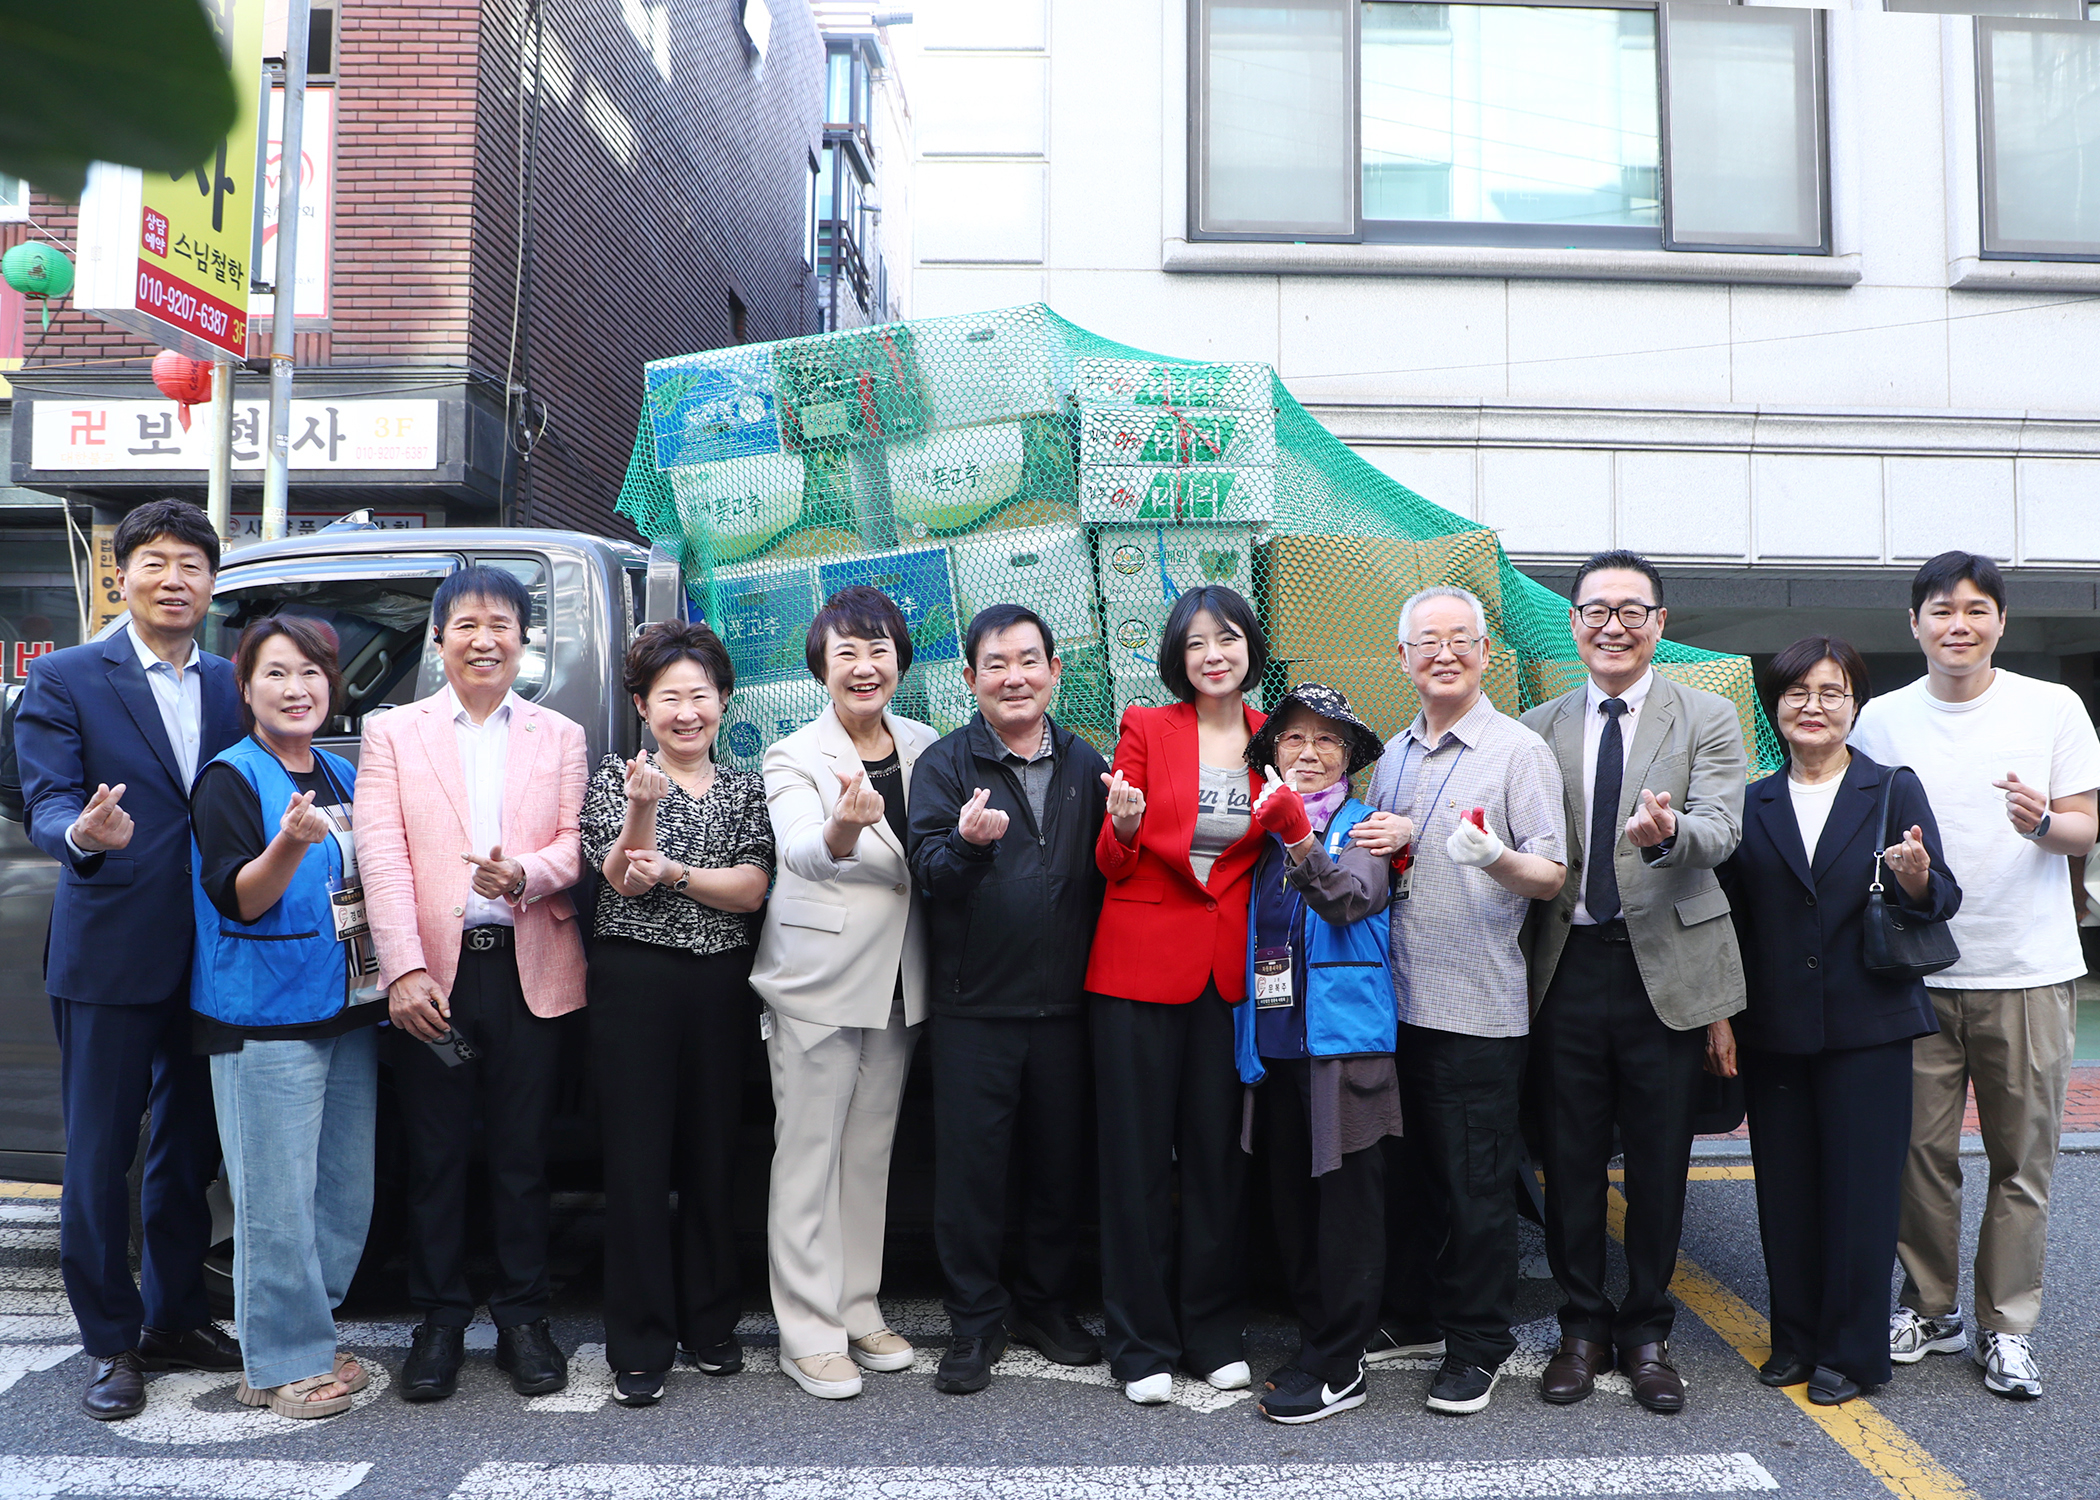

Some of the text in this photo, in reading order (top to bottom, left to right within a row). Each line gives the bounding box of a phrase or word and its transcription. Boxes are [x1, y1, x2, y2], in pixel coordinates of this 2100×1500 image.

[145, 212, 167, 237] 상담
[144, 232, 166, 255] 예약
[173, 232, 244, 291] 스님철학
[139, 272, 246, 345] 010-9207-6387 3F
[374, 416, 414, 438] 3F
[60, 452, 116, 465] 대한불교
[356, 446, 428, 460] 010-9207-6387
[931, 460, 981, 494] 풋고추
[714, 490, 762, 525] 풋고추
[1150, 550, 1188, 565] 로메인
